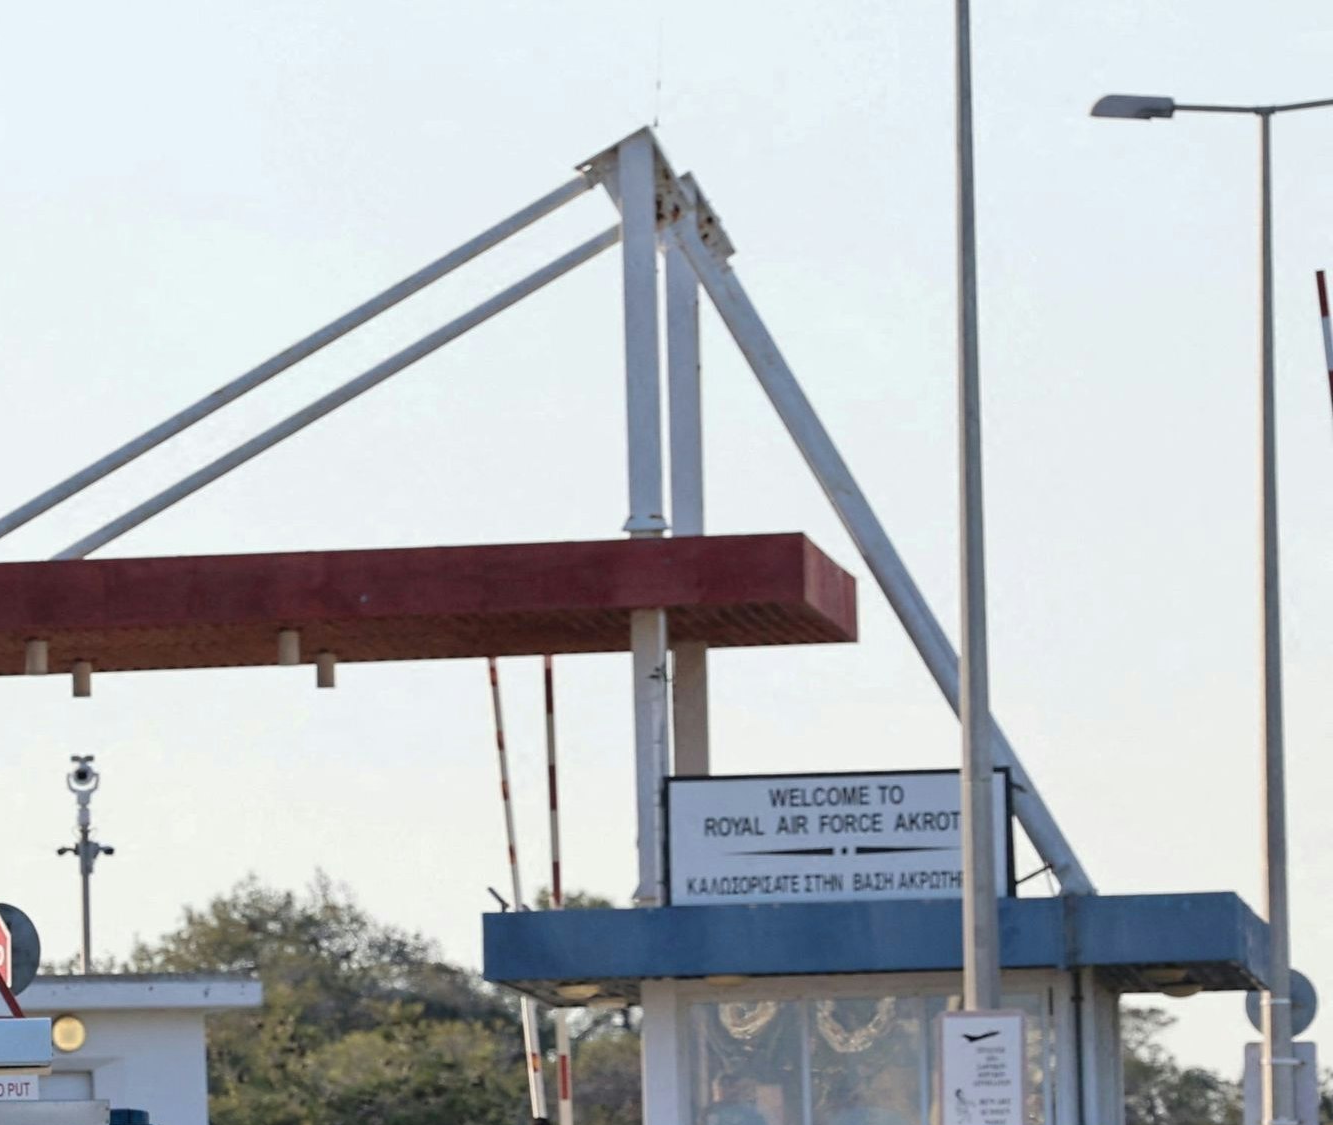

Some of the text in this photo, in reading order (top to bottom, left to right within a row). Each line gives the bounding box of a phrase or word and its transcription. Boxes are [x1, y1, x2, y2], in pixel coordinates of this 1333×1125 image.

[770, 785, 904, 807] WELCOME TO
[704, 812, 961, 836] ROYAL AIR FORCE AKROT
[7, 1082, 30, 1097] PUT
